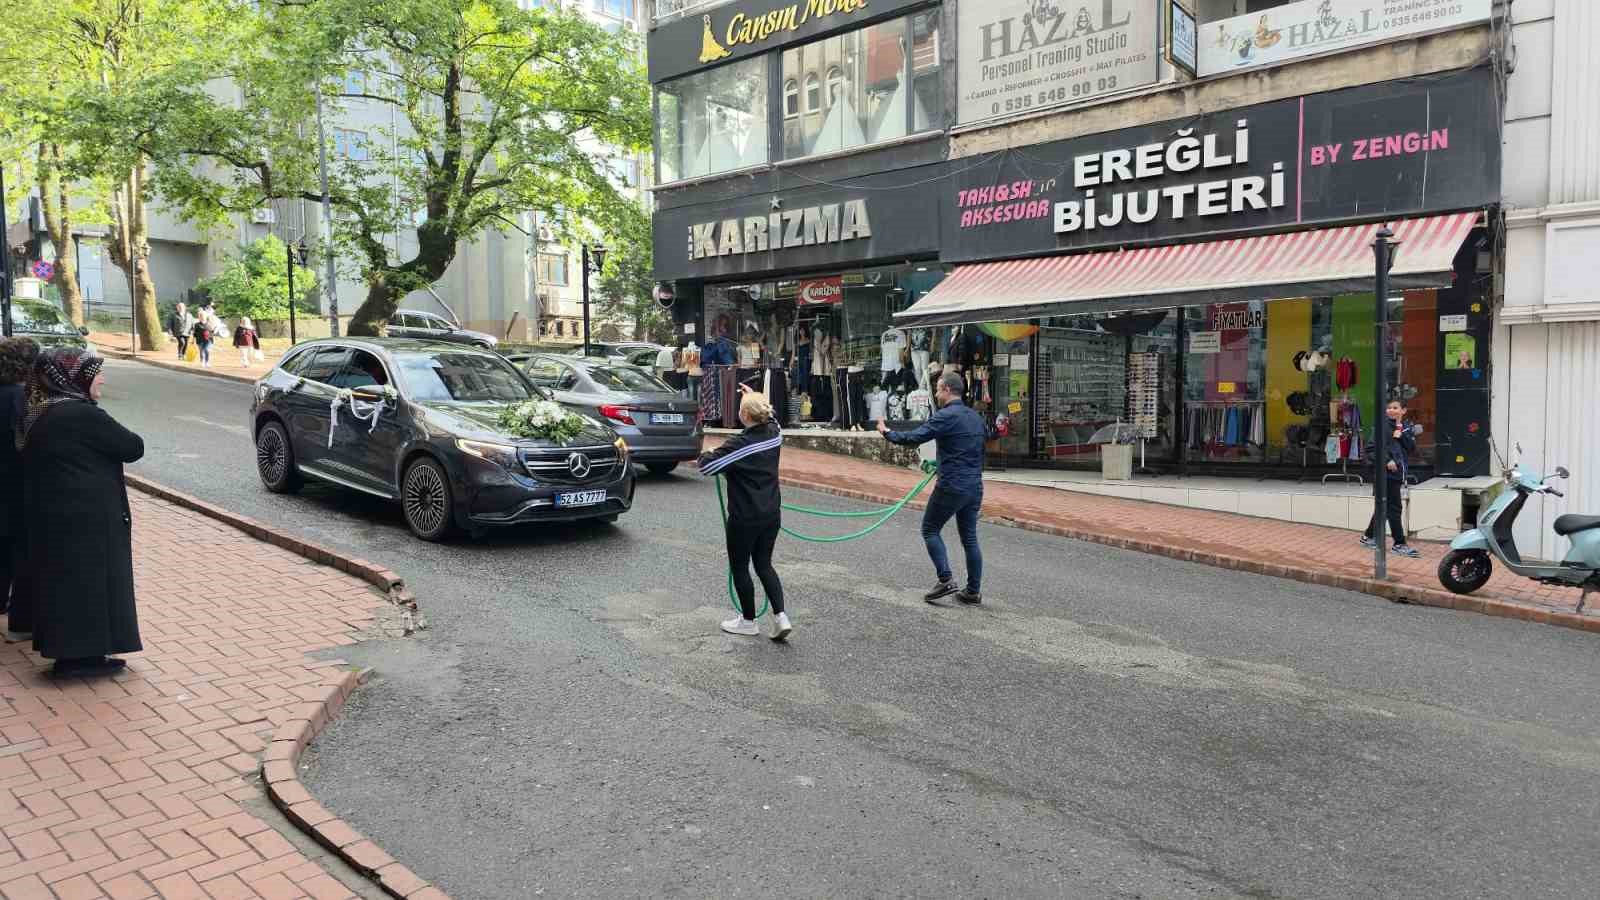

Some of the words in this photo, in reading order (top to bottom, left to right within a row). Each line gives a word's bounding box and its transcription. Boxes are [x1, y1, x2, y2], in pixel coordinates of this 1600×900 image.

[982, 53, 1032, 82] Personal
[1037, 45, 1081, 68] Traning
[1086, 31, 1127, 57] Studio
[991, 102, 1000, 114] 0
[1005, 94, 1032, 112] 535
[1072, 81, 1091, 97] 90
[1097, 75, 1117, 91] 03
[1073, 118, 1249, 188] EREĞLİ
[1310, 143, 1342, 166] BY
[960, 199, 1050, 228] AKSESUAR
[1053, 161, 1285, 233] BİJUTERİ
[693, 197, 872, 260] KARİZMA
[561, 494, 570, 505] 52
[573, 493, 584, 504] AS
